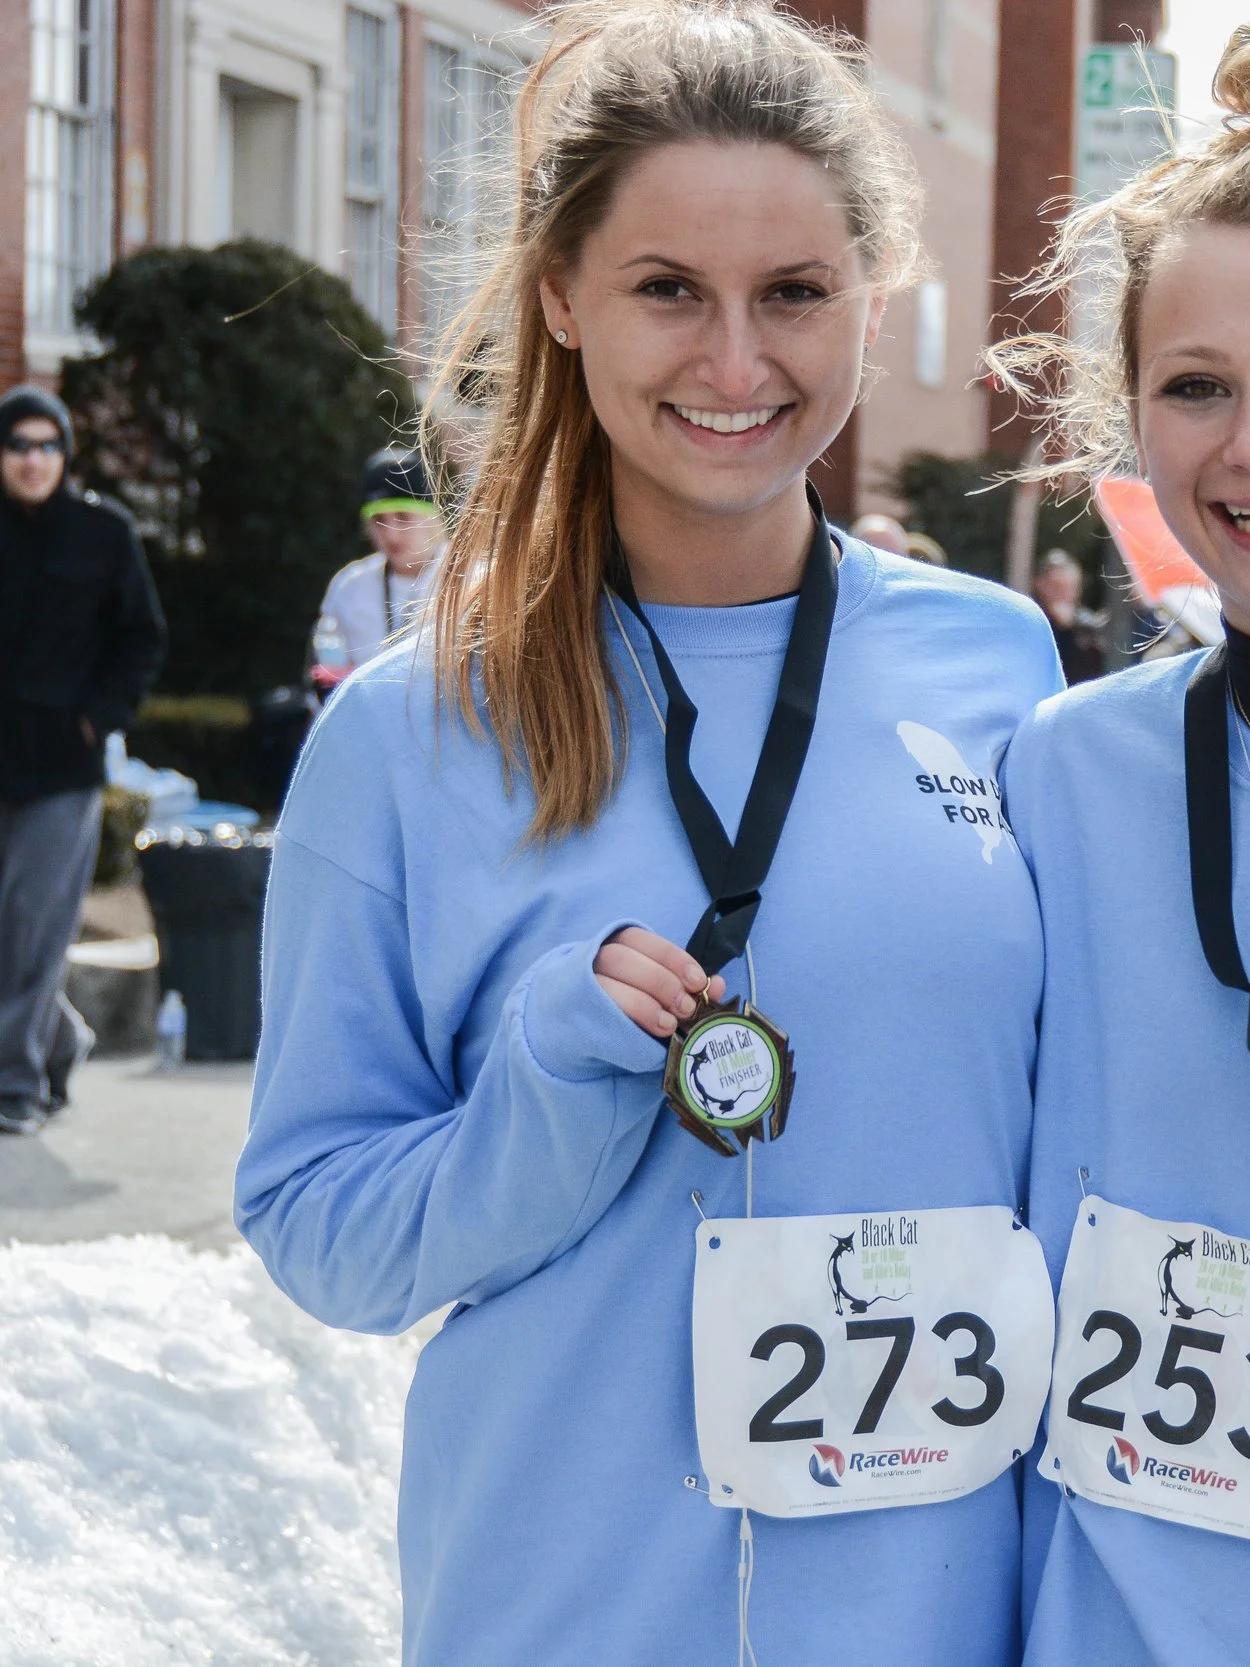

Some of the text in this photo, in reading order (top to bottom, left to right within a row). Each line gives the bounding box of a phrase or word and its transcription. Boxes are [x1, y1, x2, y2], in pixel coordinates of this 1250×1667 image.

[915, 774, 987, 796] SLOW
[942, 804, 994, 827] FOR
[708, 1030, 753, 1060] Black Cat
[719, 1064, 762, 1088] FINISHER
[862, 1216, 918, 1247] Black Cat
[1202, 1231, 1237, 1262] Black
[749, 1311, 1006, 1443] 273
[849, 1446, 949, 1472] RaceWire
[871, 1467, 922, 1479] RaceWire.com
[1143, 1456, 1238, 1492] RaceWire
[1160, 1480, 1209, 1497] RaceWire.com
